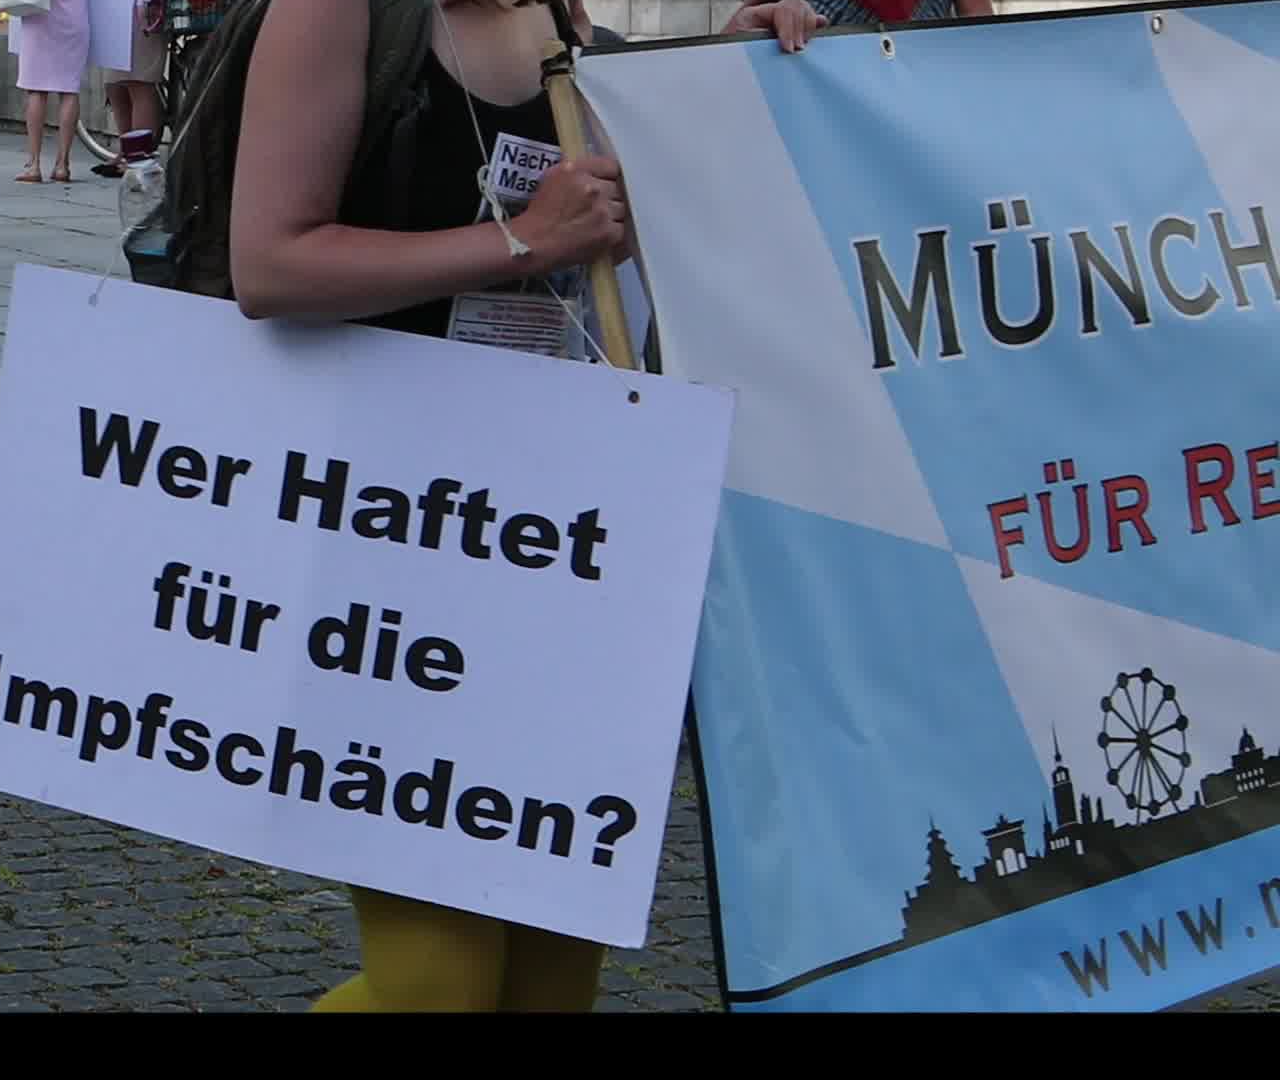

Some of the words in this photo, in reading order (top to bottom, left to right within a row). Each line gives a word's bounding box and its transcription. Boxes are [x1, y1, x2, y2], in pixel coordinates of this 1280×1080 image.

[500, 143, 560, 171] Nach
[852, 198, 1280, 370] MÜNCH
[79, 406, 251, 507] Wer
[278, 451, 607, 580] Haftet
[986, 457, 1158, 579] FÜR
[1182, 440, 1280, 535] RE
[153, 562, 279, 652] für
[307, 603, 465, 692] die
